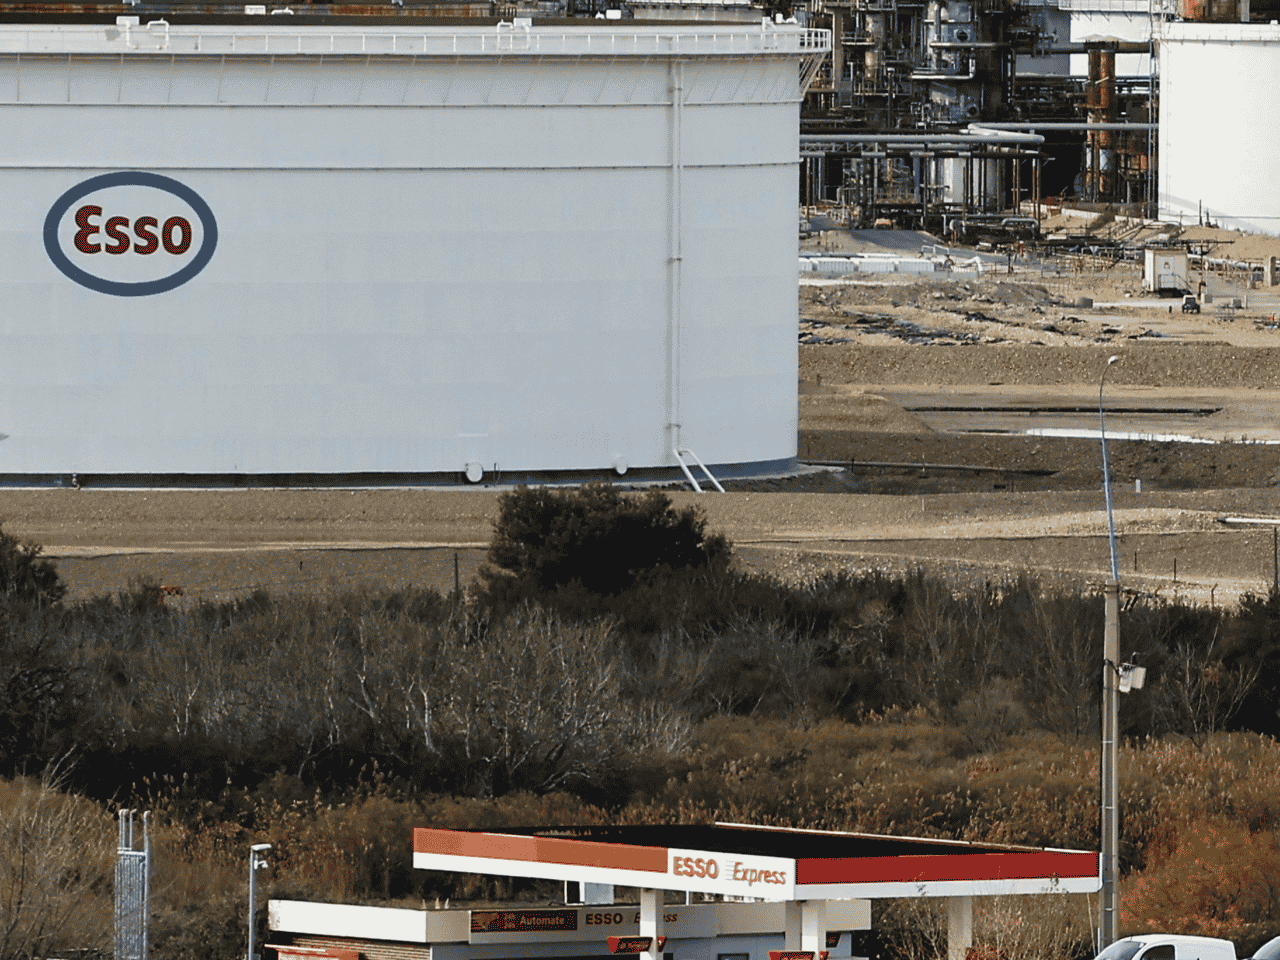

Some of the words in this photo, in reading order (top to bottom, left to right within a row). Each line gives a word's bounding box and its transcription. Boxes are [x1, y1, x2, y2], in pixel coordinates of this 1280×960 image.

[73, 204, 193, 256] Esso
[672, 856, 719, 879] ESSO
[732, 861, 787, 887] Express
[519, 914, 565, 926] Automate
[585, 912, 623, 925] ESSO
